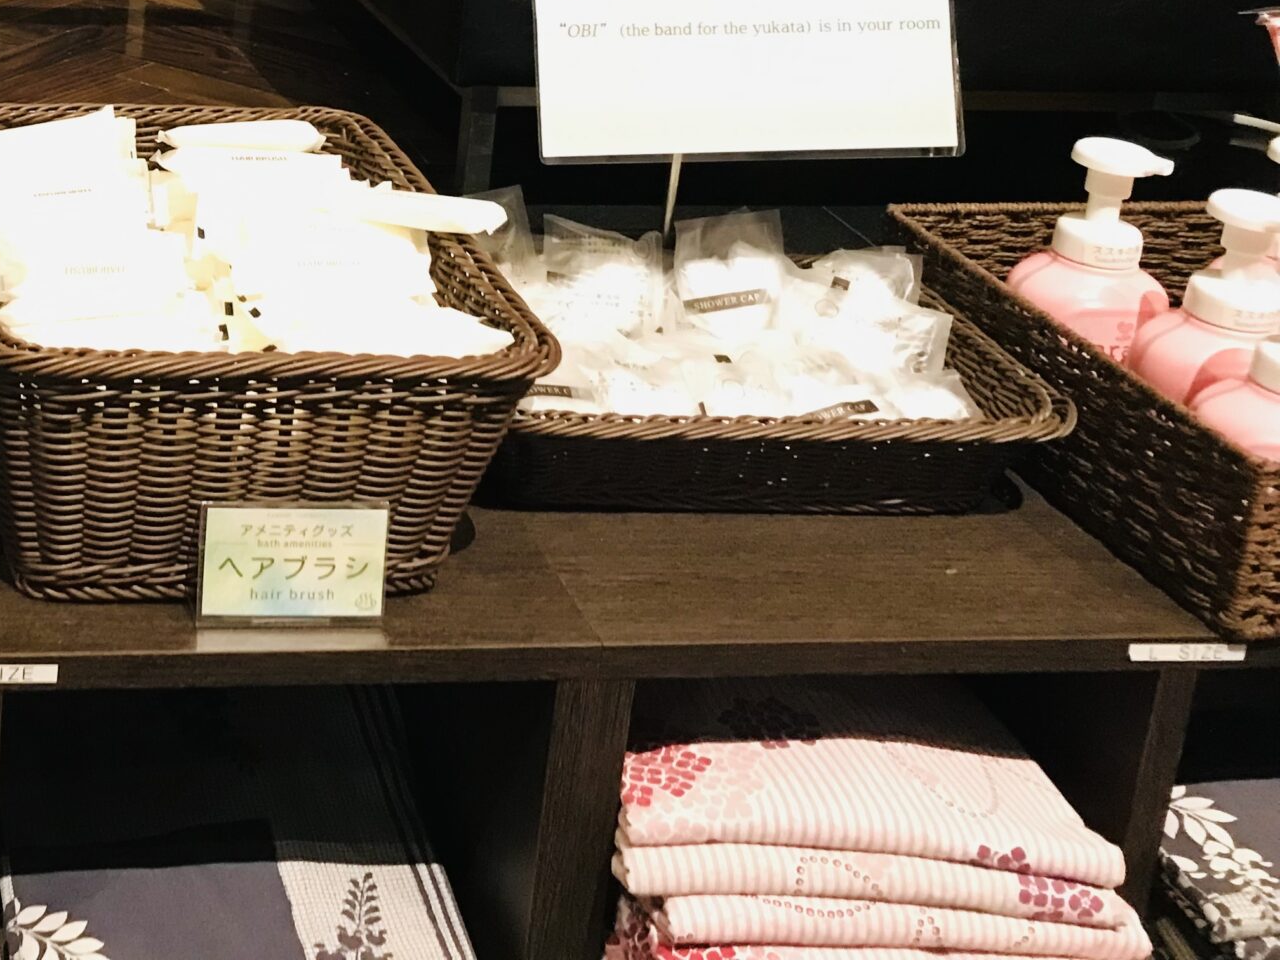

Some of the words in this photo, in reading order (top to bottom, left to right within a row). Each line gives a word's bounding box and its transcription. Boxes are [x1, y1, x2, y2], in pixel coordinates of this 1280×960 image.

[620, 23, 650, 38] (the
[654, 22, 692, 36] band
[697, 21, 718, 36] for
[724, 21, 748, 35] the
[753, 20, 811, 37] yukata)
[819, 19, 832, 32] is
[837, 18, 851, 32] in
[857, 19, 892, 33] your
[899, 18, 940, 31] room
[693, 296, 737, 310] SHOWER
[740, 293, 761, 304] CAP
[240, 524, 354, 538] アメニティグッズ
[283, 540, 333, 548] amenities
[218, 555, 369, 581] ヘアブラシ
[249, 588, 282, 601] hair
[289, 588, 335, 601] brush
[1178, 645, 1224, 661] SIZE
